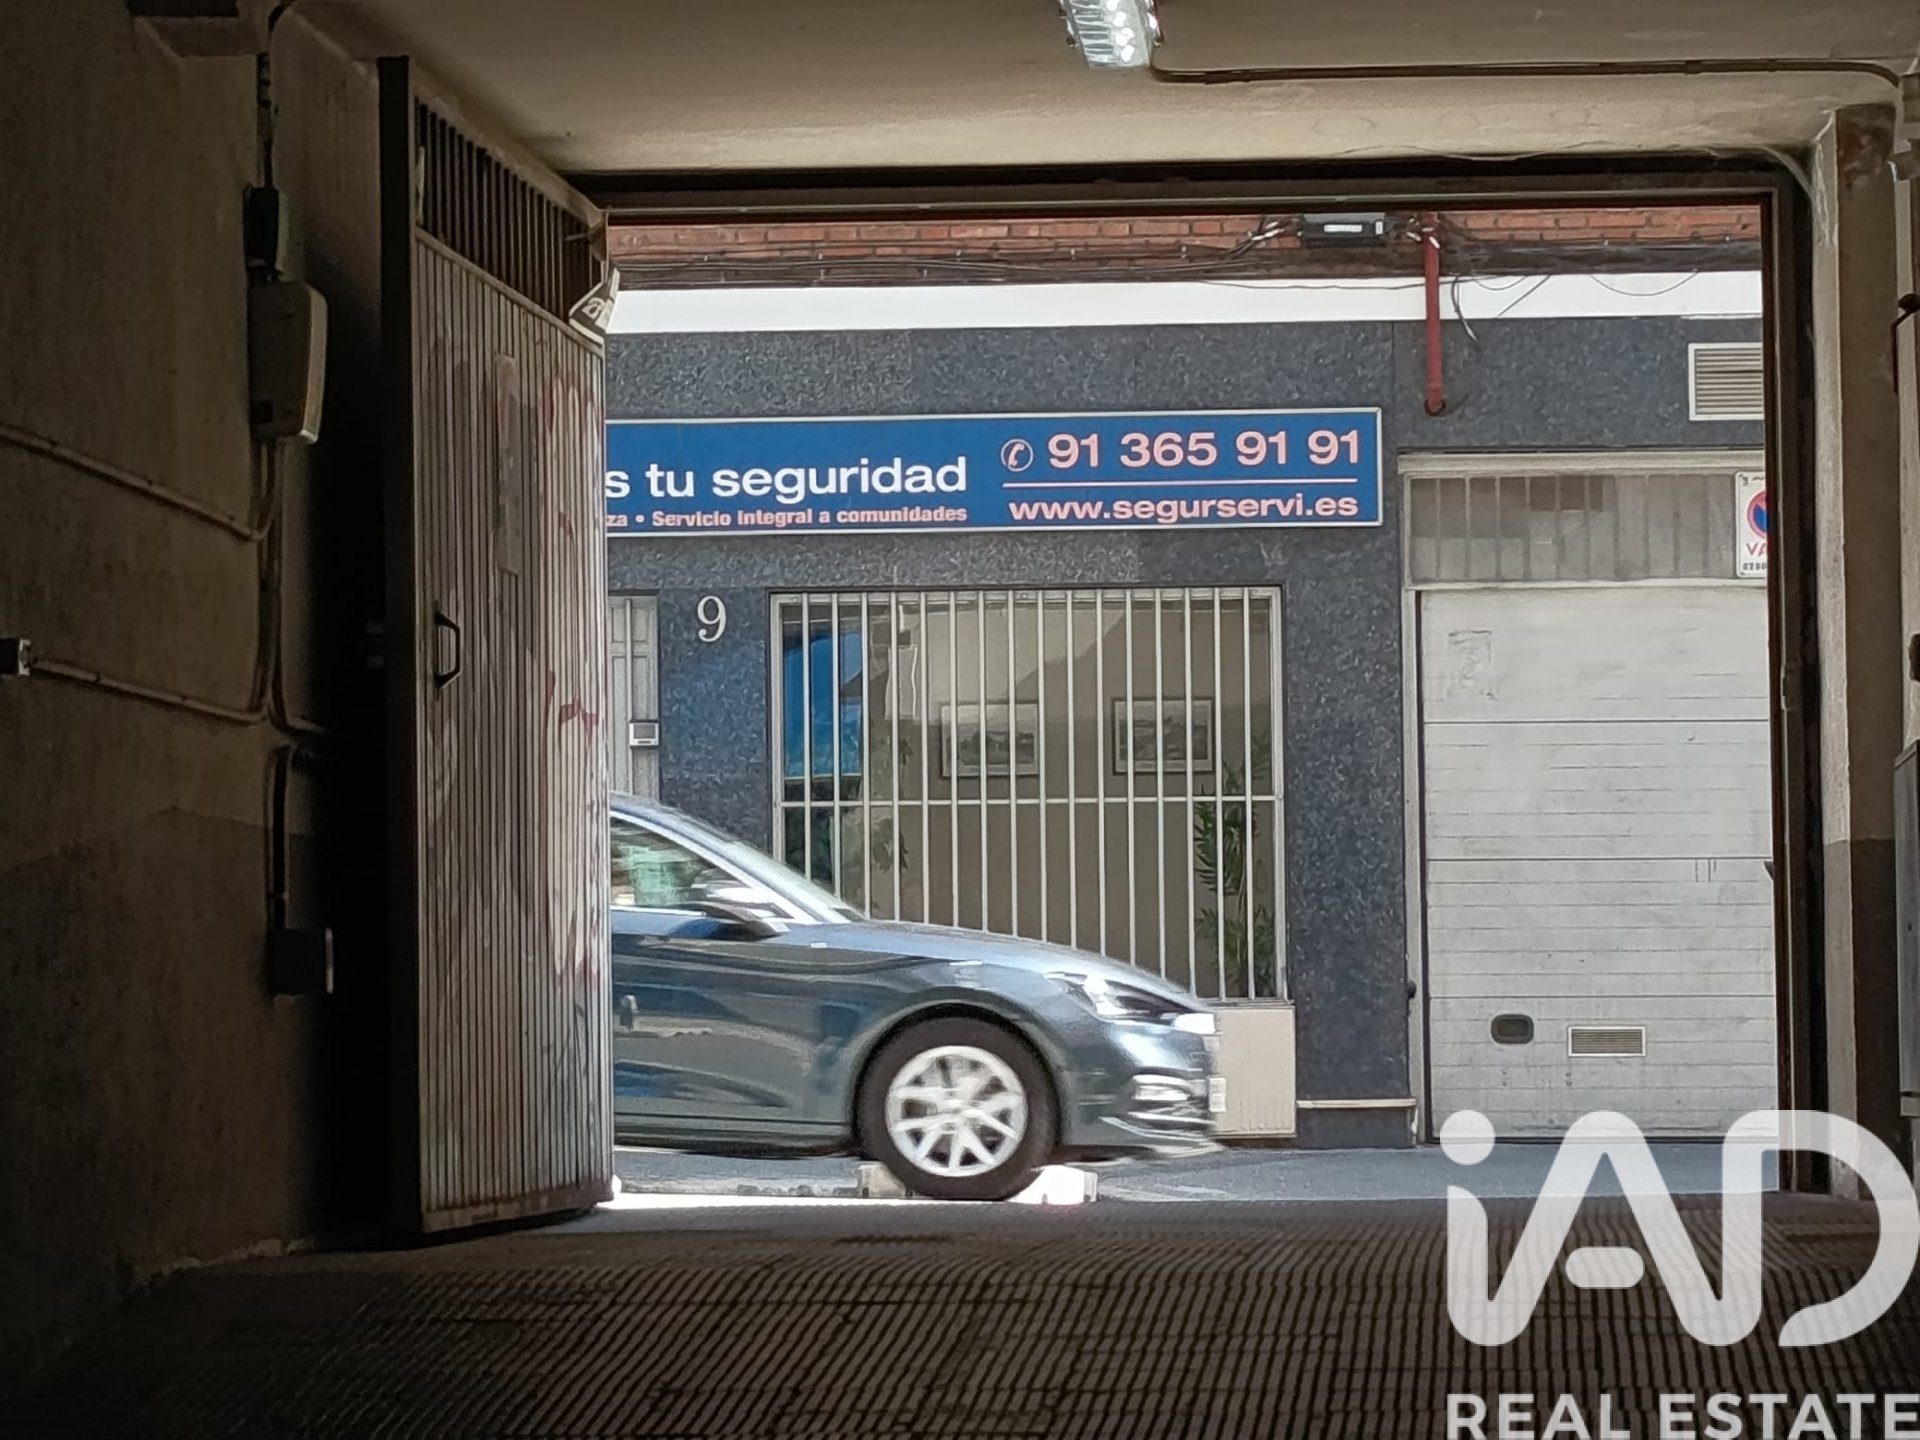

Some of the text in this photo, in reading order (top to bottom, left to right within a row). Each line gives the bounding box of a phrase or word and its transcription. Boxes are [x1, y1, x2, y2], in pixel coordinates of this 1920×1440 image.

[1047, 429, 1360, 469] 91 365 91 91
[645, 463, 695, 498] tu
[712, 456, 967, 504] seguridad
[652, 510, 731, 527] Servicio
[818, 511, 830, 524] a
[837, 506, 968, 524] comunidades
[1009, 493, 1359, 524] www.segurservi.es
[697, 595, 727, 642] 9
